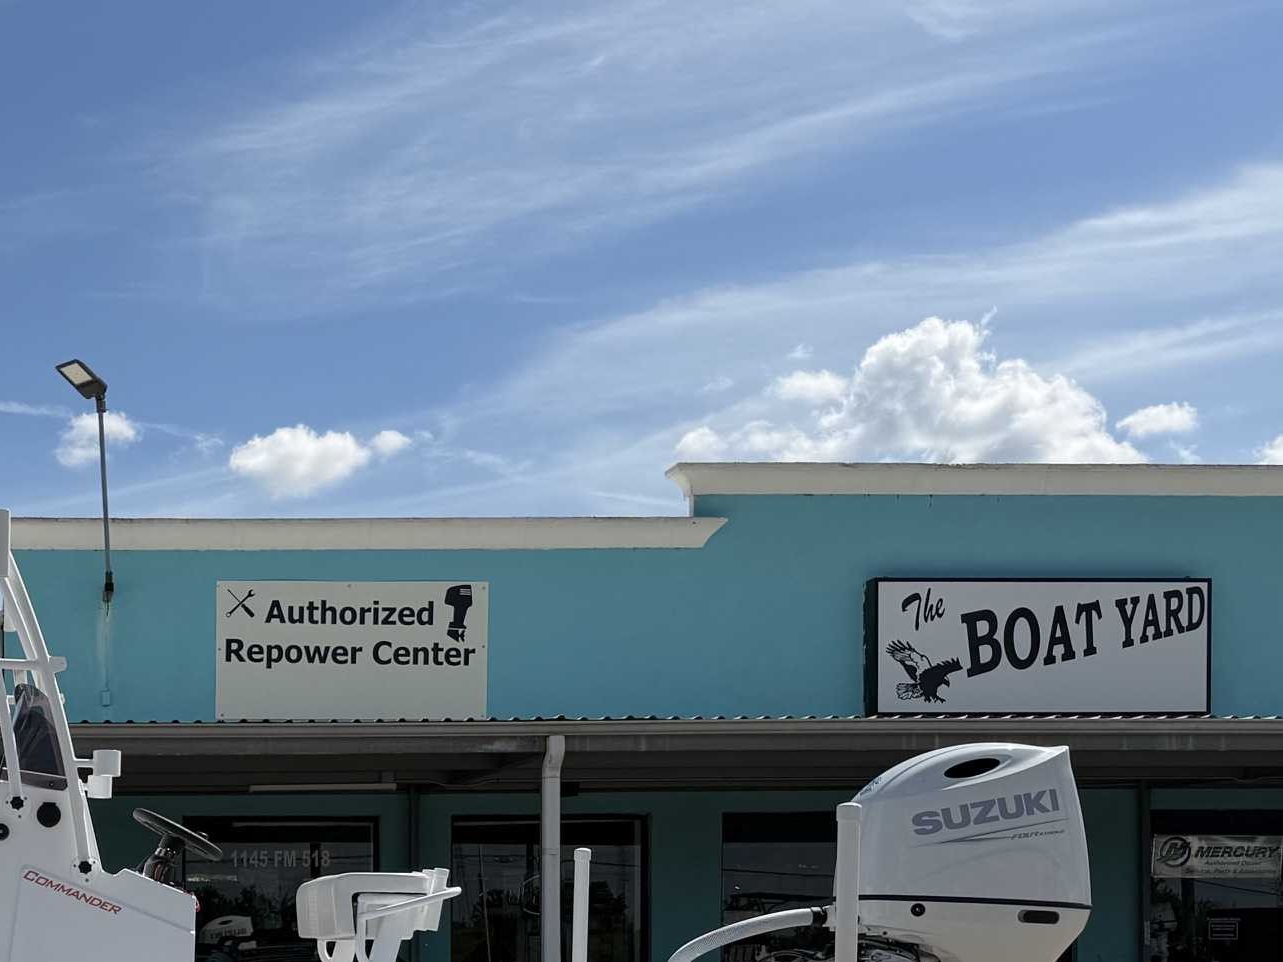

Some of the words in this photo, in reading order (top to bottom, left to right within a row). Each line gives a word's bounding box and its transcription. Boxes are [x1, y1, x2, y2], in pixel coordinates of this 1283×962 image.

[264, 599, 434, 626] Authorized
[901, 587, 945, 631] The
[960, 599, 1102, 678] BOAT
[1115, 585, 1205, 648] YARD
[224, 638, 363, 669] Repower
[372, 640, 476, 667] Center
[911, 788, 1061, 836] SUZUKI
[230, 850, 268, 868] 1145
[274, 850, 296, 868] FM
[302, 850, 331, 867] 518
[1194, 845, 1279, 858] MERCURY
[22, 870, 122, 915] COMMANDER
